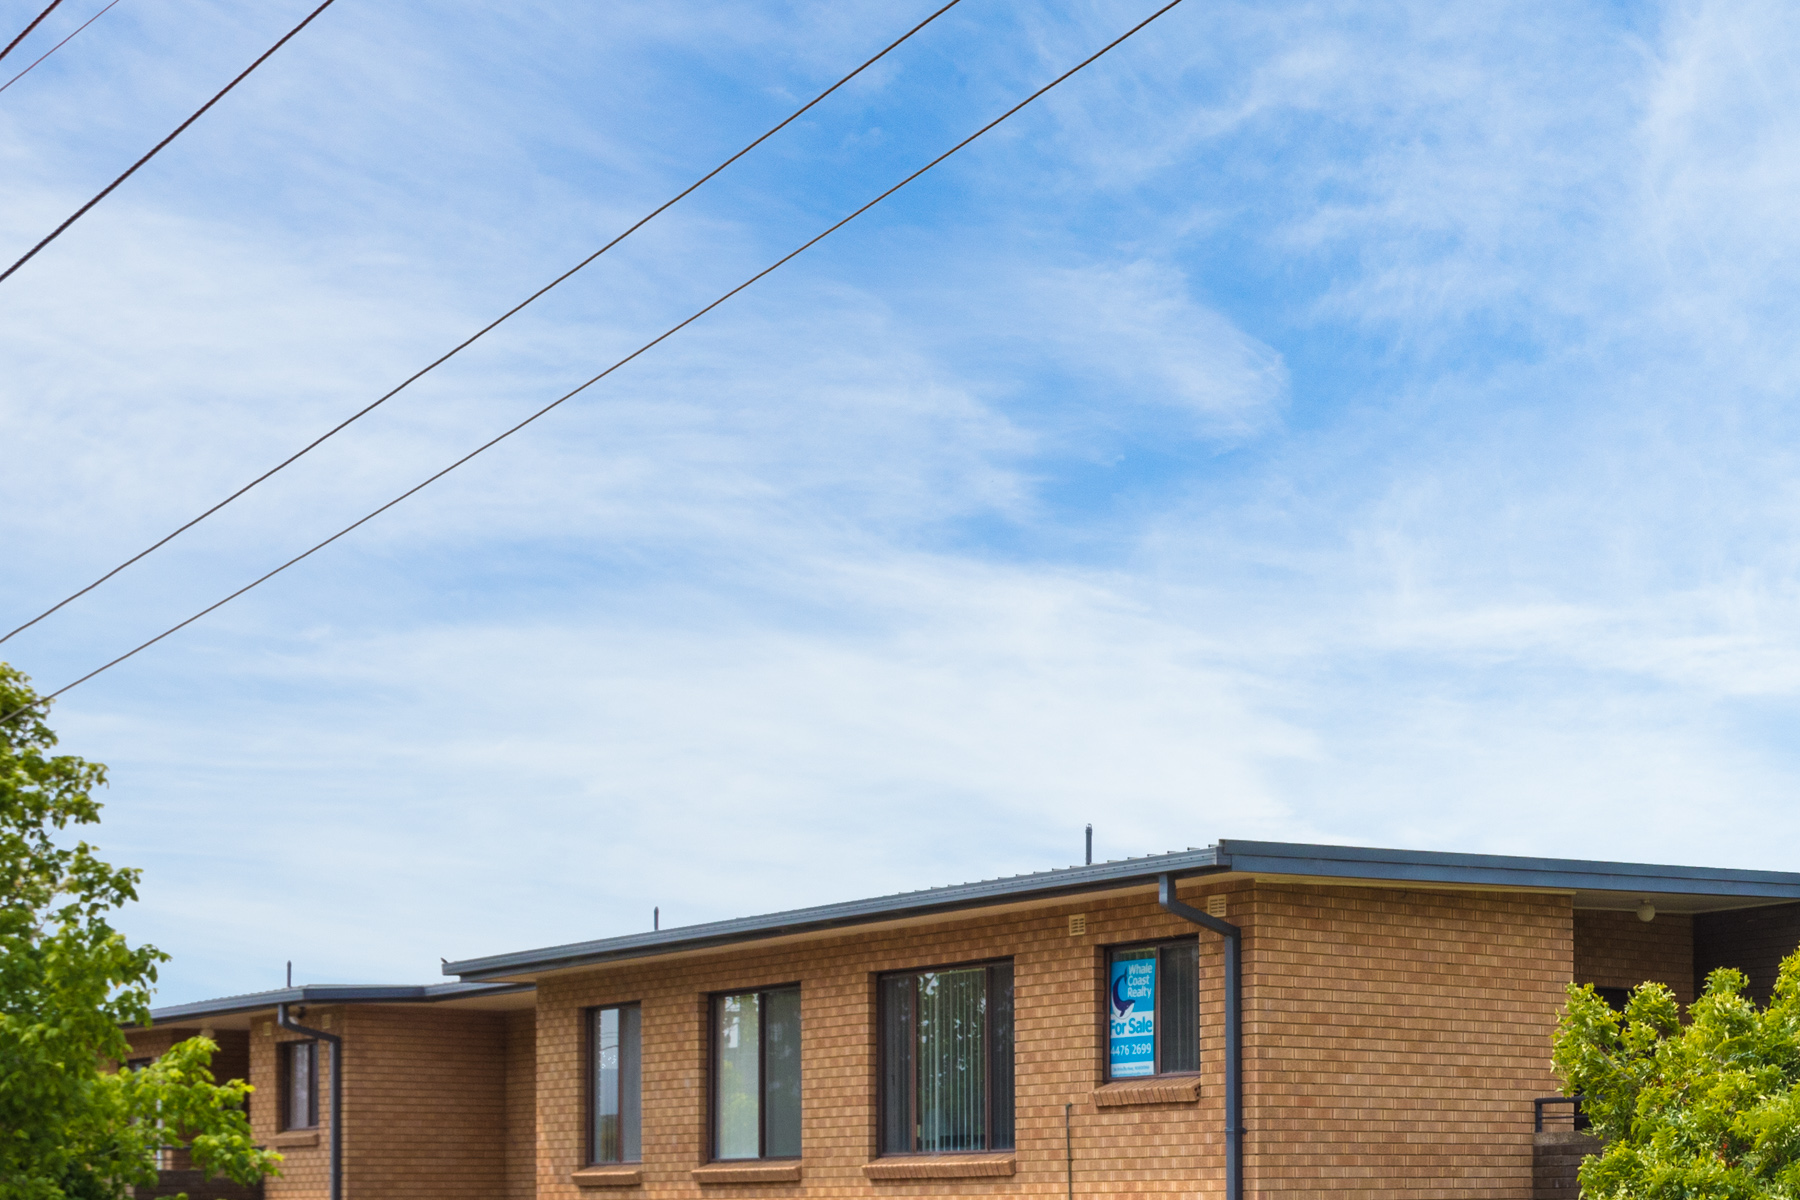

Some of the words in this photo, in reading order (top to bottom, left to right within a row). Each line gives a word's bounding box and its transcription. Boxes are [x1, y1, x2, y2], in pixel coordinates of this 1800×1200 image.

[1128, 963, 1153, 974] Whale
[1127, 975, 1150, 986] Coast
[1127, 985, 1152, 999] Realty
[1110, 1019, 1127, 1035] For
[1128, 1016, 1153, 1034] Sale
[1110, 1044, 1130, 1056] 4476
[1131, 1043, 1152, 1055] 2699
